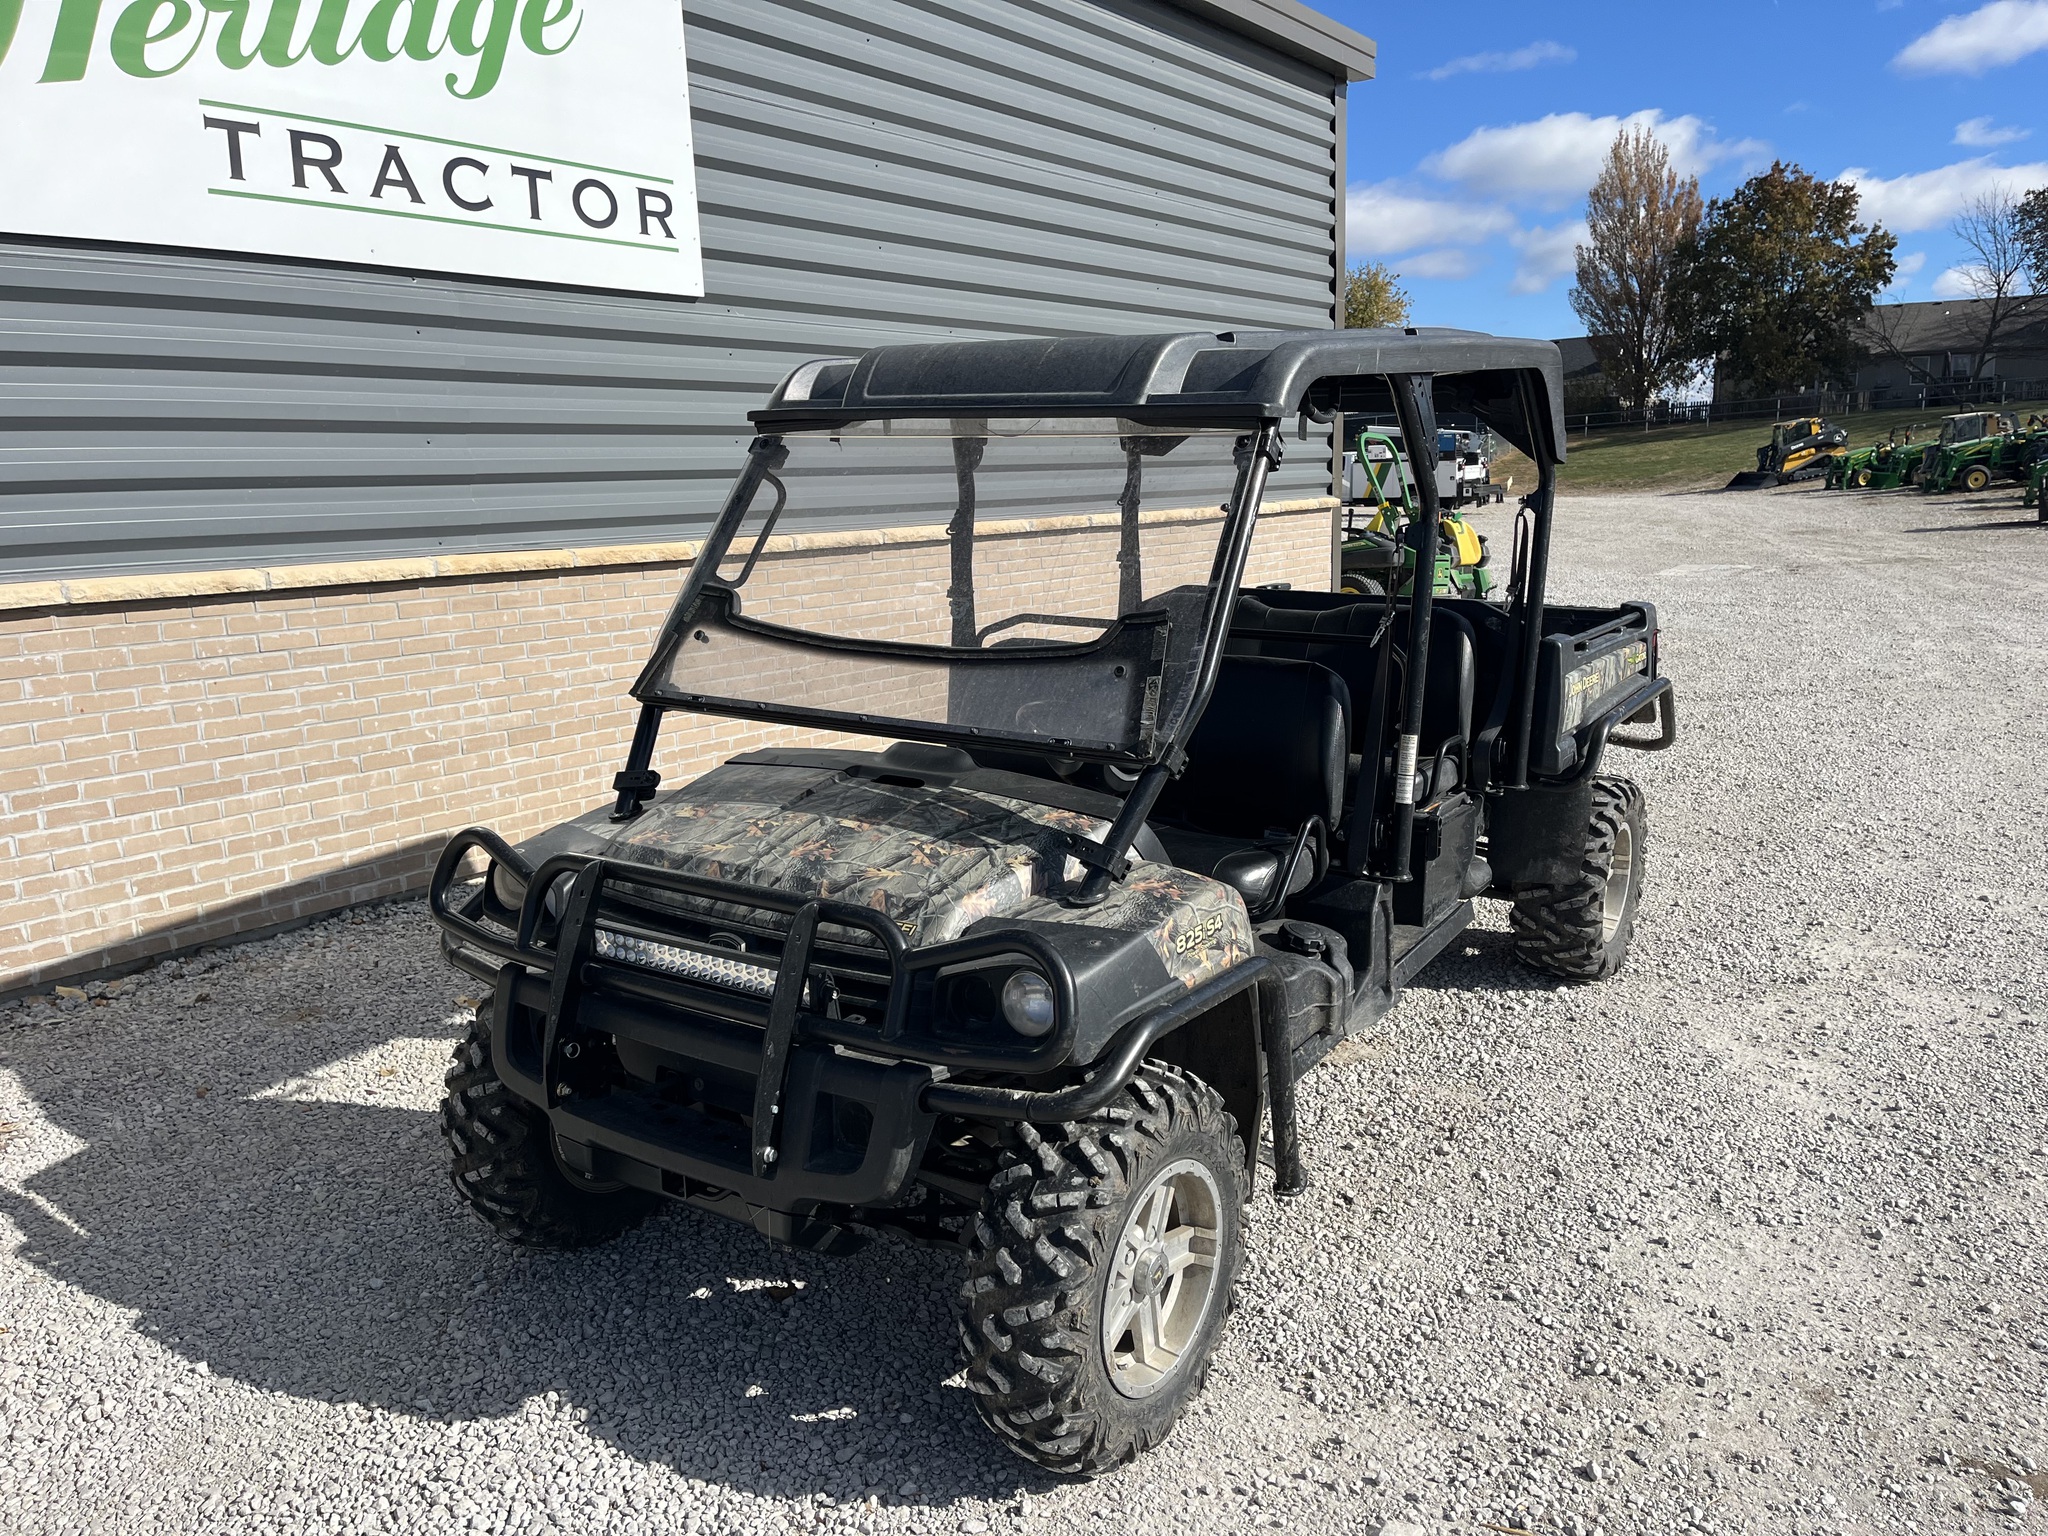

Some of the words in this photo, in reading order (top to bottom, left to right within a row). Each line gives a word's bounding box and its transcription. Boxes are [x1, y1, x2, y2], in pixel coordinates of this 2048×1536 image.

[203, 115, 677, 239] TRACTOR
[896, 922, 917, 936] FI
[1206, 913, 1223, 937] S4
